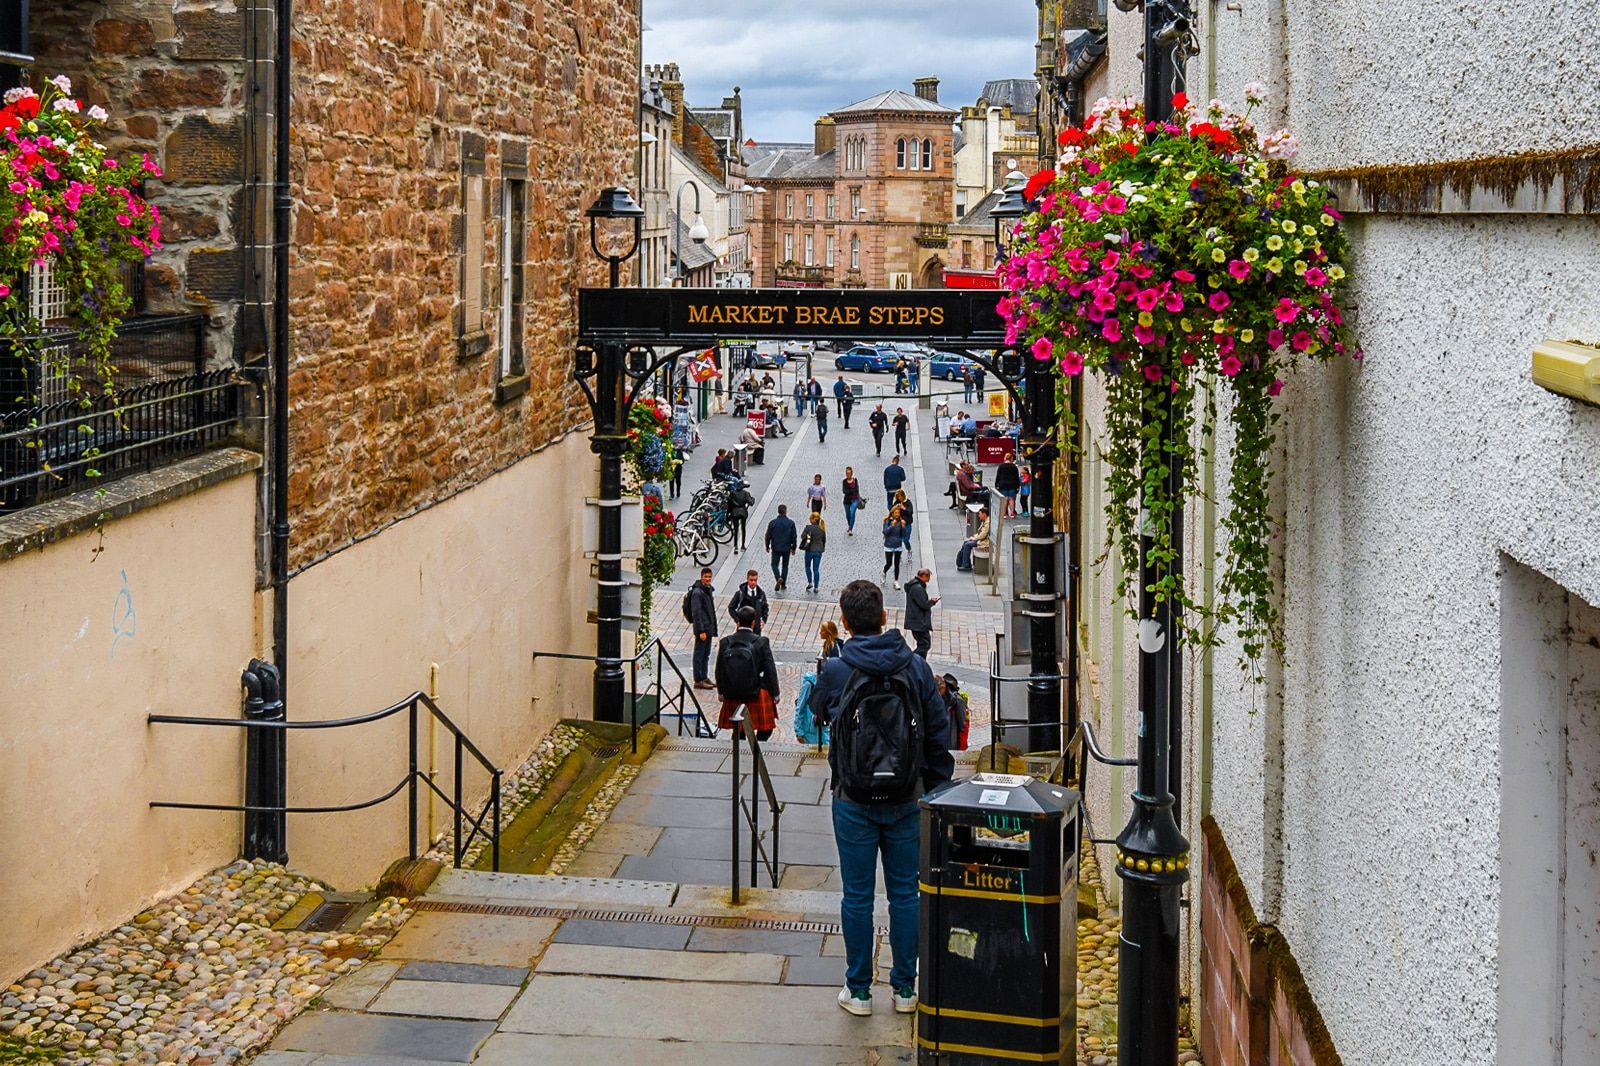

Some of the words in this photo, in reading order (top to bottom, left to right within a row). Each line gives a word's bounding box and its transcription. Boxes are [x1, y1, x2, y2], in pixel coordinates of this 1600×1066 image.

[688, 305, 788, 324] MARKET
[795, 306, 861, 324] BRAE
[869, 306, 945, 325] STEPS
[964, 871, 1012, 889] Litter
